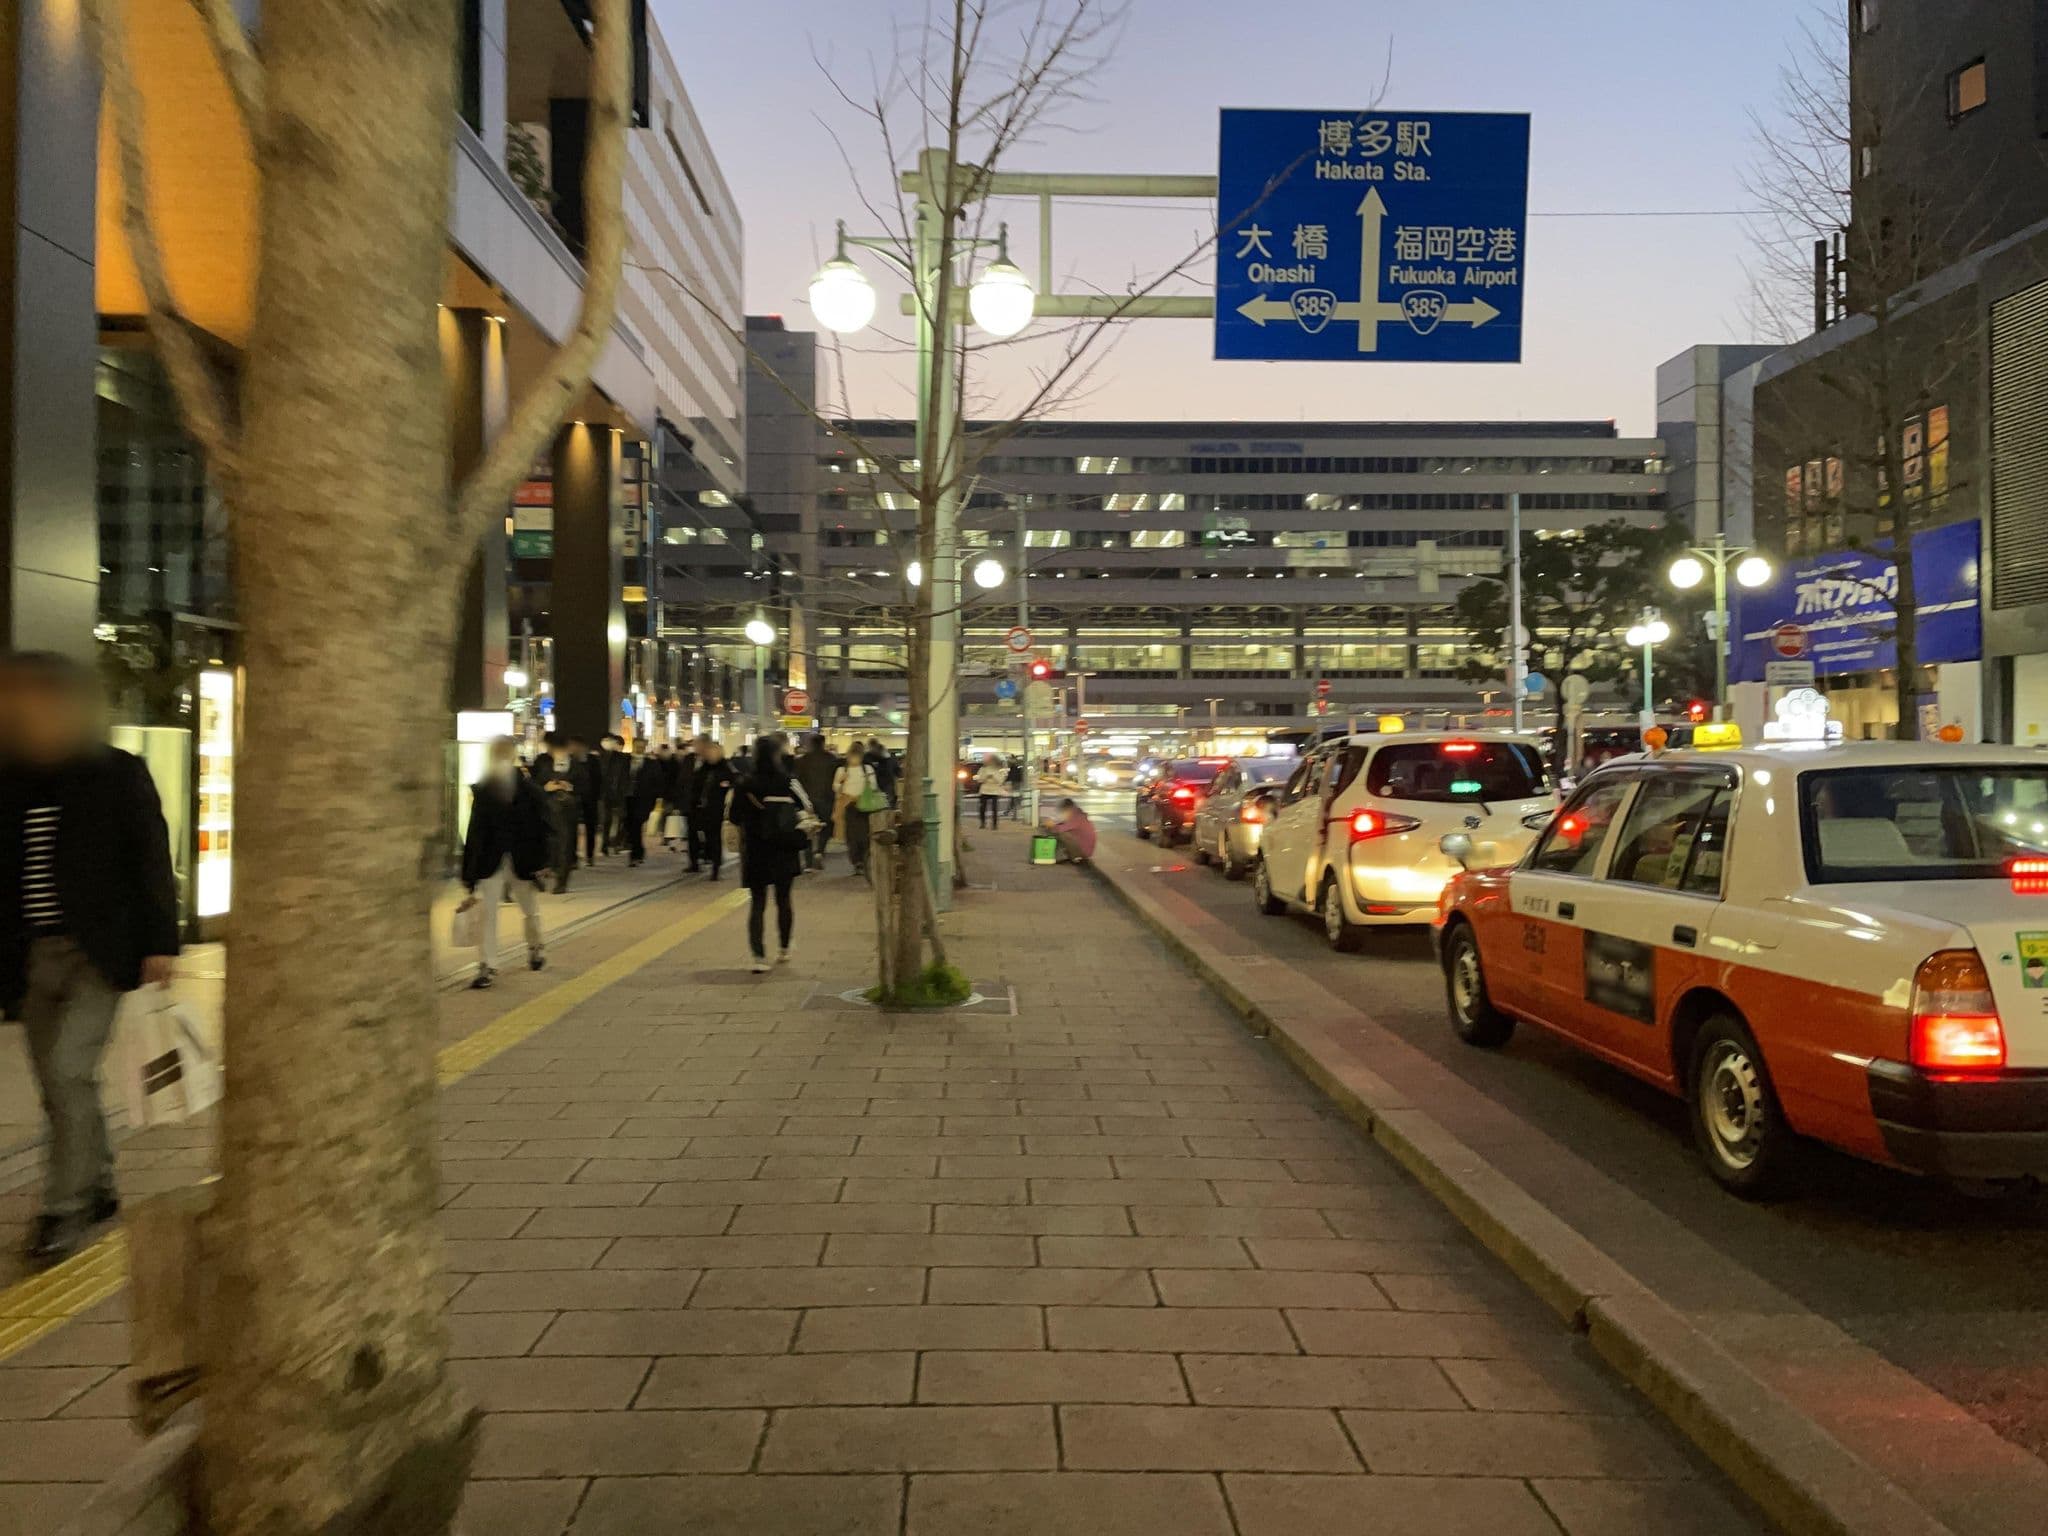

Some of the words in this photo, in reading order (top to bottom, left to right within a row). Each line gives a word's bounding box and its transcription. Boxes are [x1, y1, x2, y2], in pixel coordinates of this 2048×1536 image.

[1318, 119, 1432, 157] 博多駅
[1316, 160, 1384, 180] Hakata
[1393, 160, 1431, 181] Sta.
[1236, 223, 1329, 260] 大橋
[1394, 226, 1517, 262] 福岡空港
[1248, 263, 1315, 283] Ohashi
[1389, 266, 1456, 285] Fukuoka
[1464, 268, 1518, 289] Airport
[1295, 295, 1331, 316] 385
[1406, 296, 1442, 317] 385
